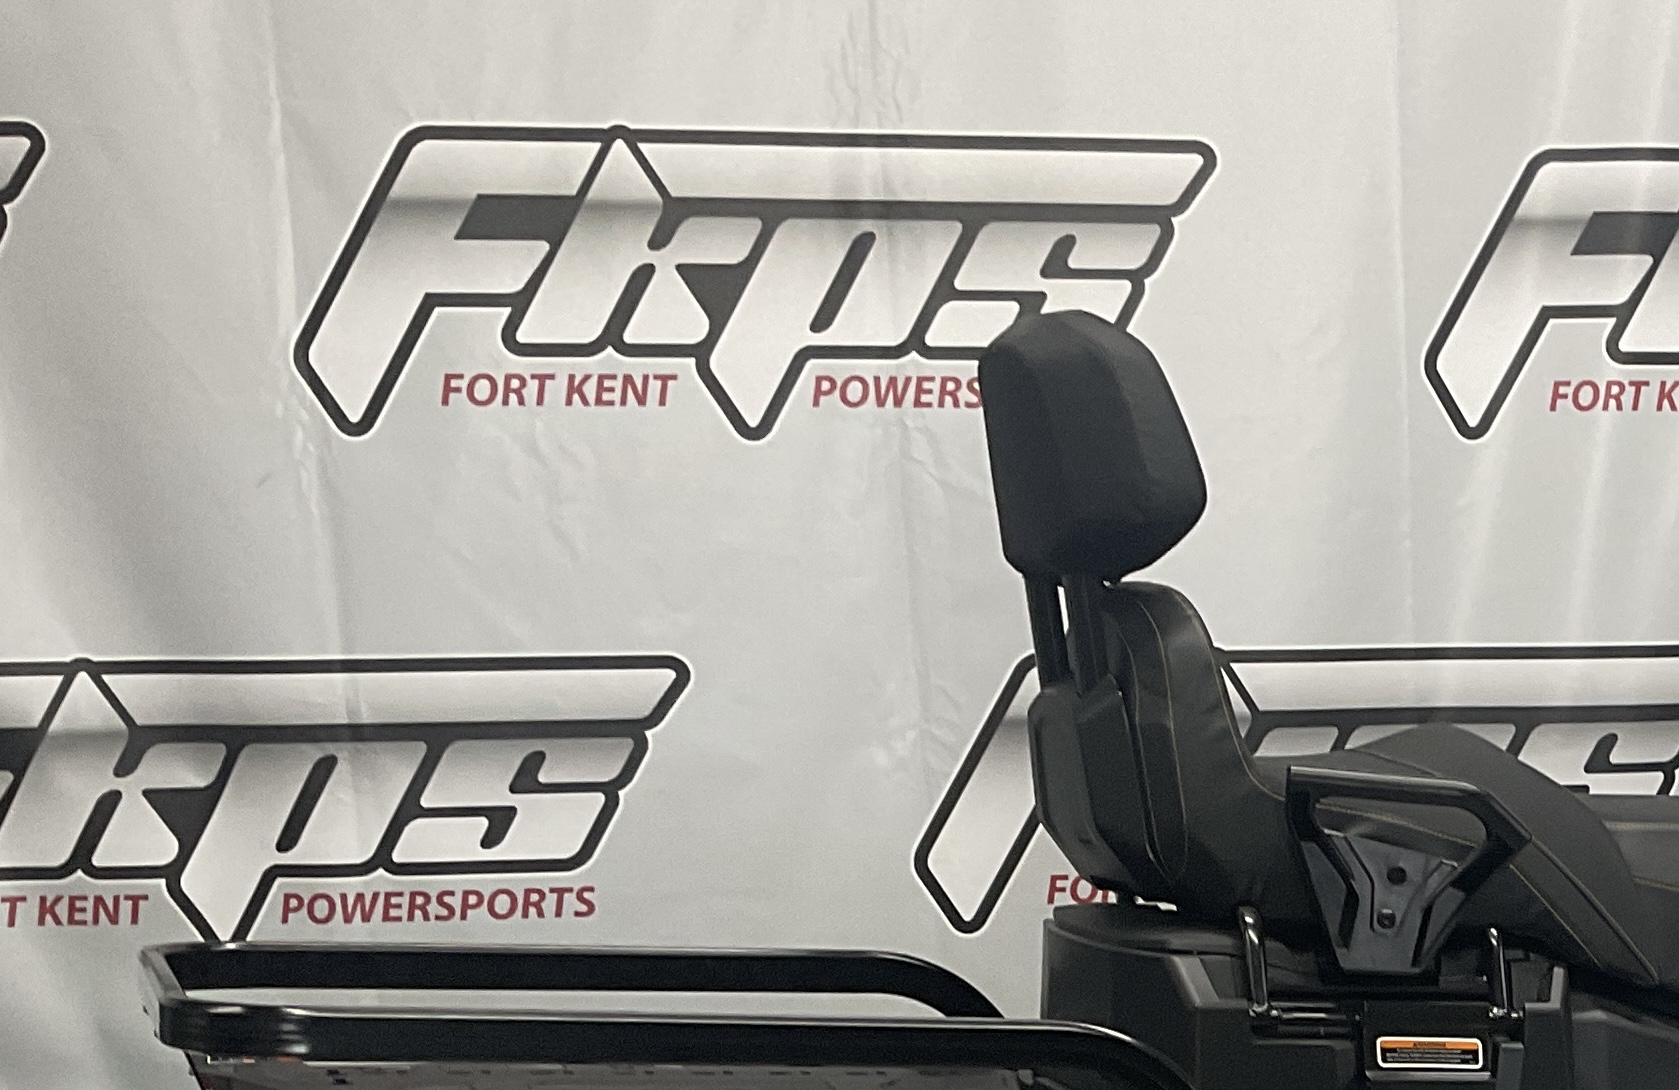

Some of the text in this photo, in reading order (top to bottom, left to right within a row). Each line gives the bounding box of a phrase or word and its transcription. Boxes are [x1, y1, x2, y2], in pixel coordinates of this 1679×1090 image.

[441, 373, 982, 408] FORT KENT POWERS
[1550, 380, 1650, 412] FORT
[37, 894, 149, 927] KENT
[280, 886, 596, 925] POWERSPORTS
